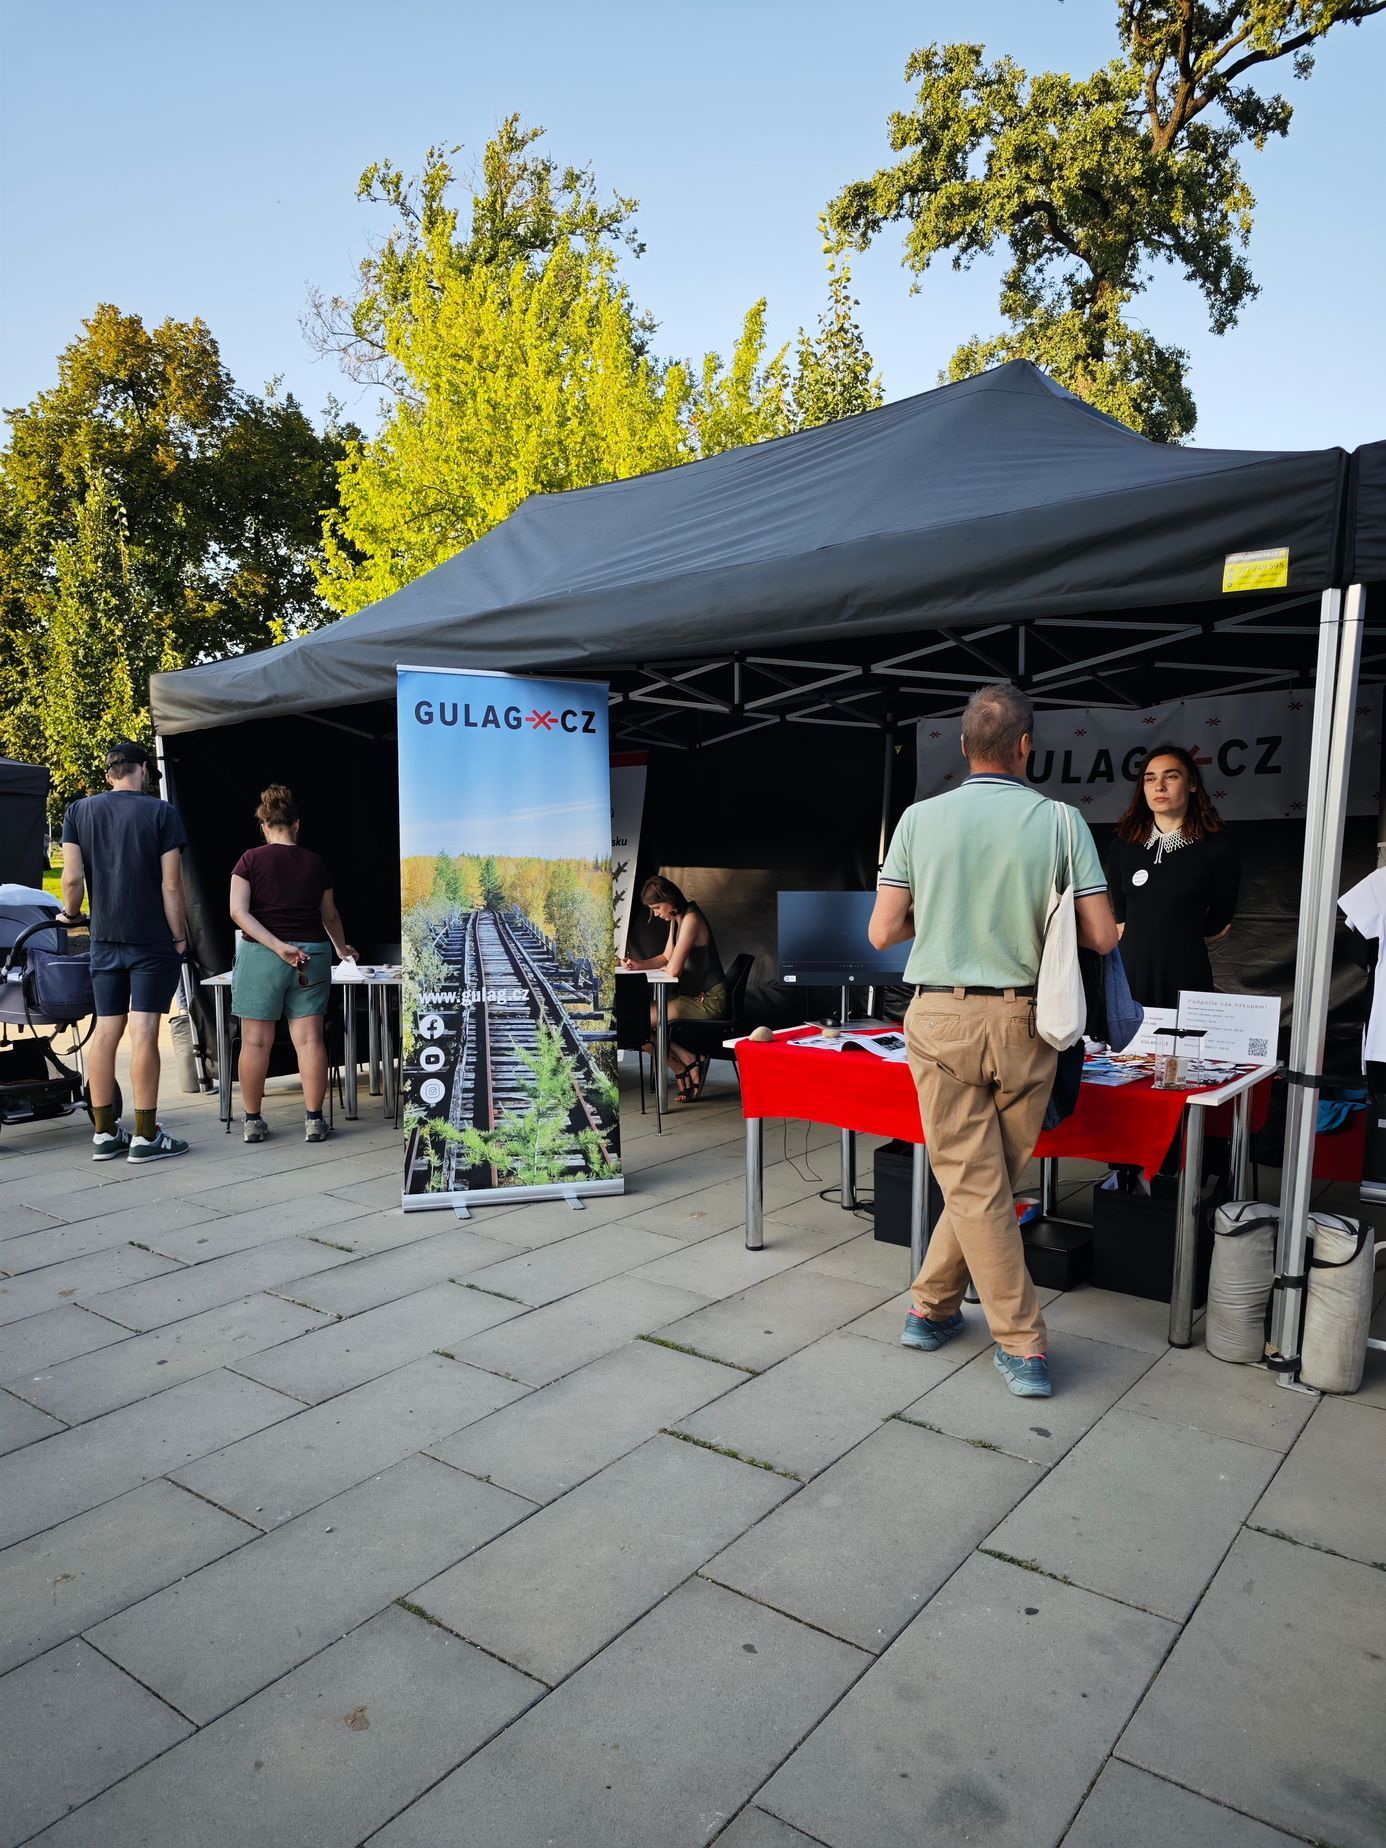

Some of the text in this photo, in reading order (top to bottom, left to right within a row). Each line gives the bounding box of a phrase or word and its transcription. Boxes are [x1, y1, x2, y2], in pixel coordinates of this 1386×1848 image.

[414, 700, 596, 734] GULAG CZ
[1026, 735, 1283, 785] ULAG CZ
[611, 836, 628, 847] sku
[418, 986, 530, 1007] www.gulag.cz
